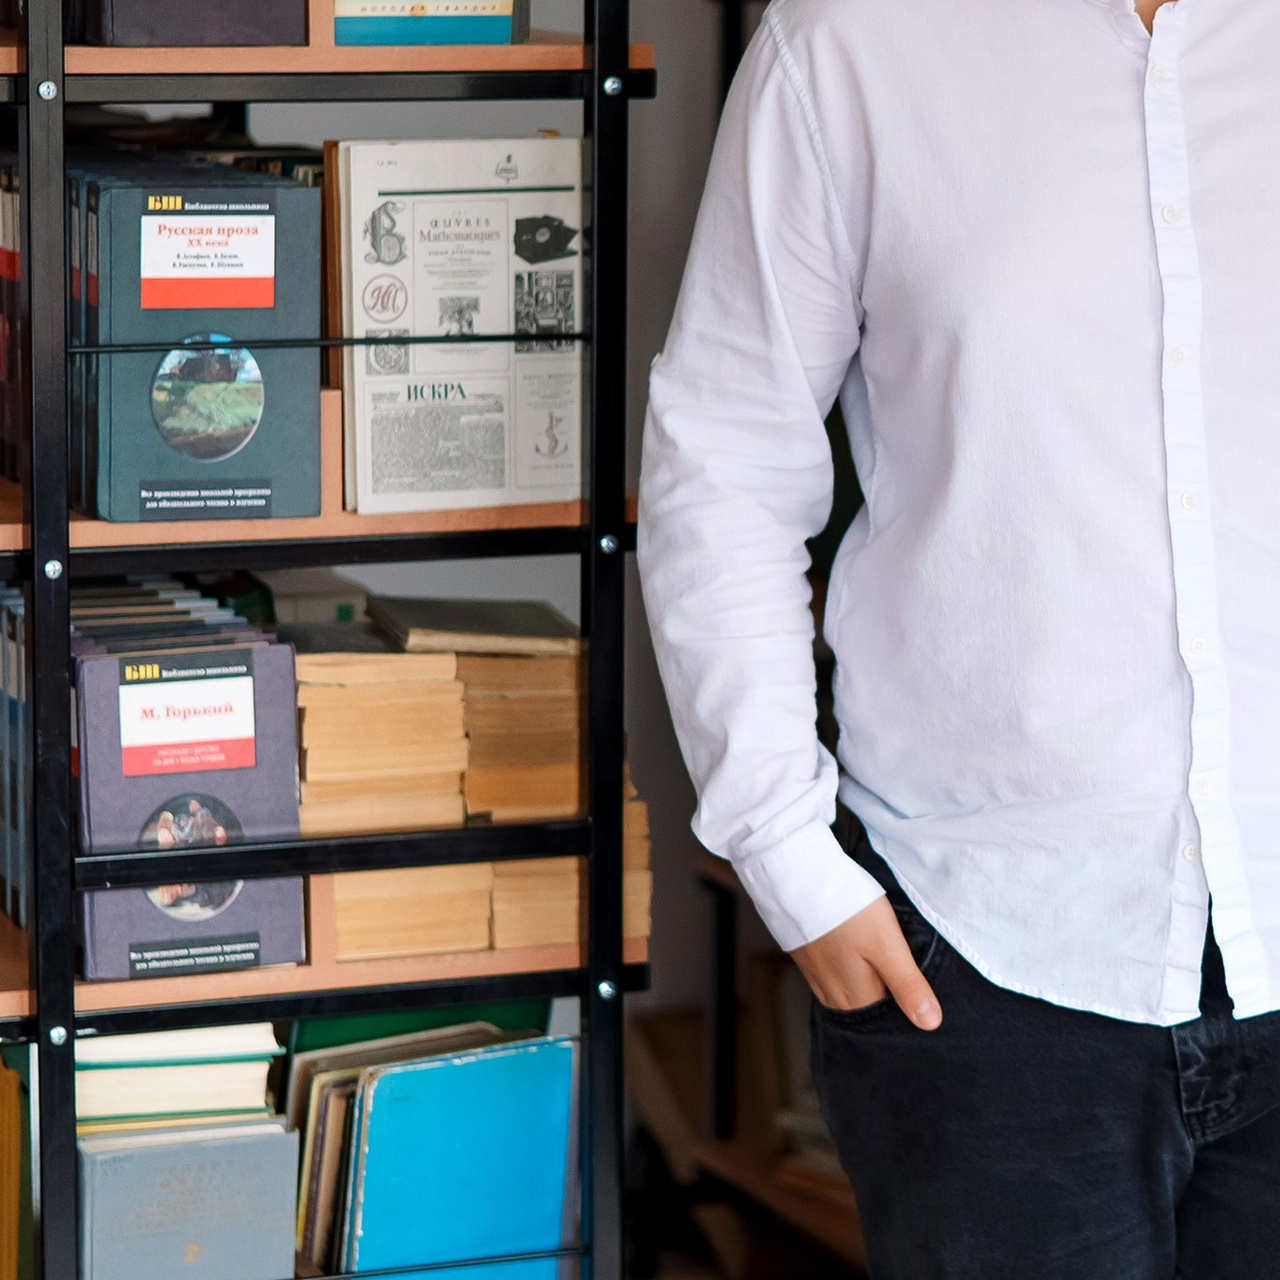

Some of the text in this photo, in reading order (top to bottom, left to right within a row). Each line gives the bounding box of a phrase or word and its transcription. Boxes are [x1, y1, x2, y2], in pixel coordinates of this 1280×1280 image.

[147, 195, 183, 211] БШ
[157, 223, 259, 239] Русская проза
[406, 382, 467, 402] ИСКРА
[124, 663, 161, 681] БШ
[165, 700, 234, 723] Горький
